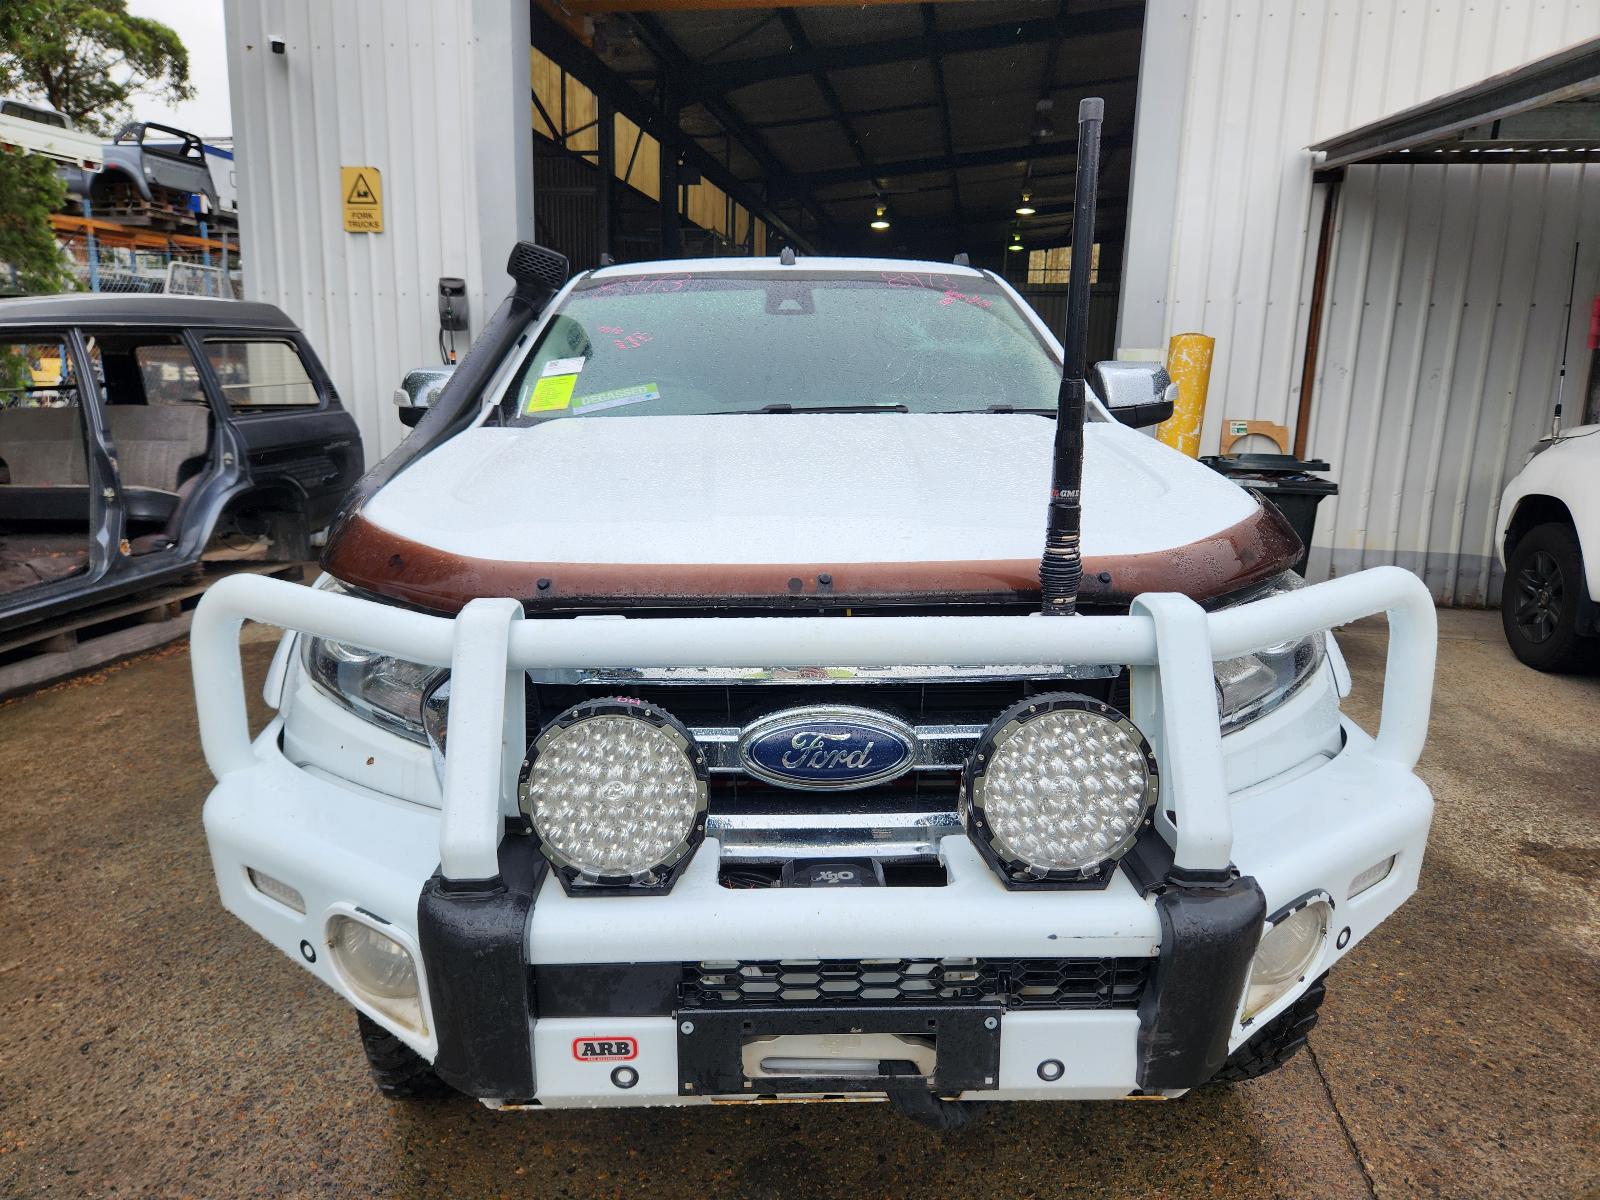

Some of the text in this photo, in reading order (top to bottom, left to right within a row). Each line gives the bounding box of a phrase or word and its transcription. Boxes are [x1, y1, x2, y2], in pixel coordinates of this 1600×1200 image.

[352, 212, 374, 220] FORK
[348, 220, 381, 229] TRUCKS
[581, 385, 648, 406] DEGASSED
[781, 731, 873, 769] Ford
[581, 1041, 631, 1056] ARB
